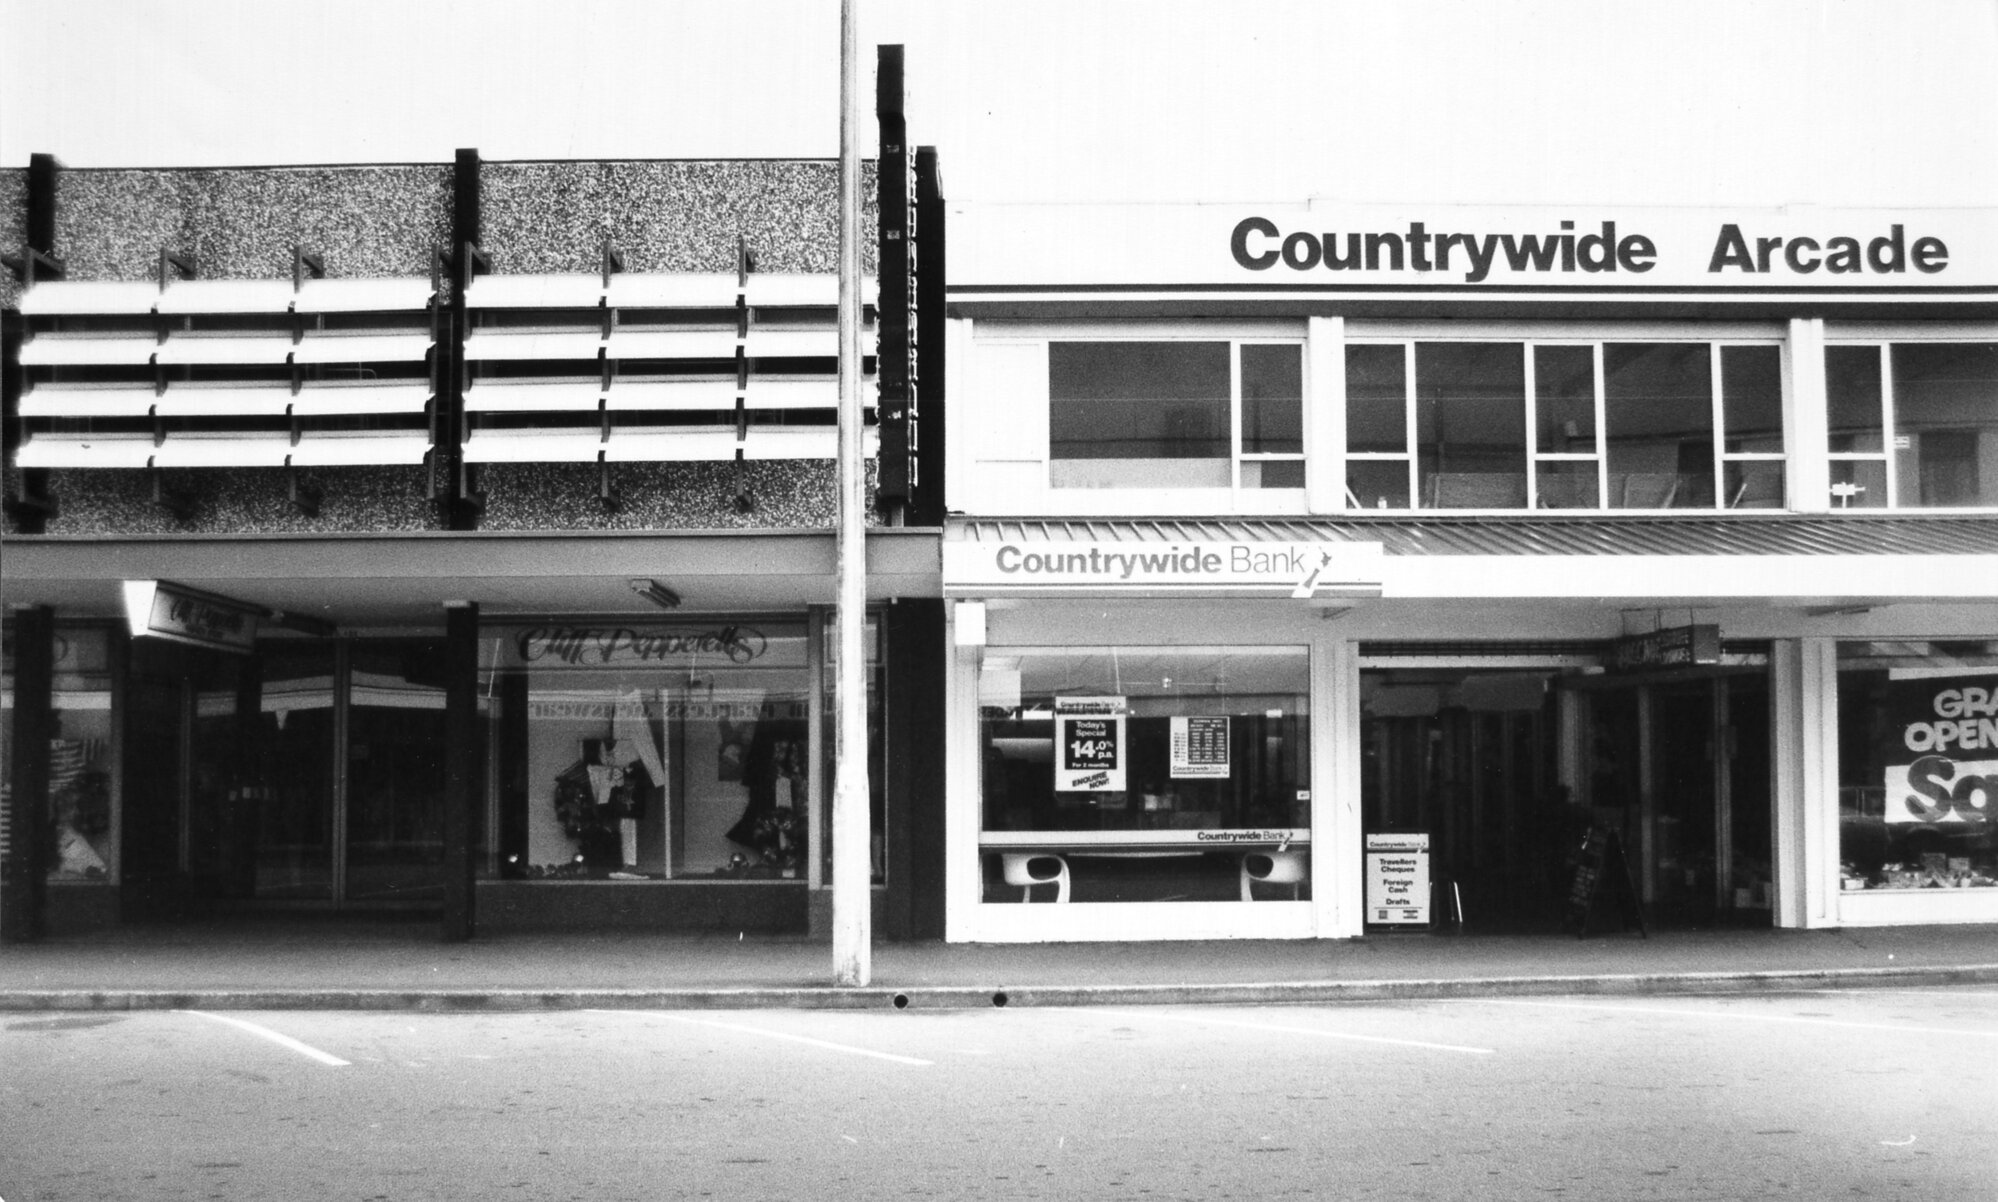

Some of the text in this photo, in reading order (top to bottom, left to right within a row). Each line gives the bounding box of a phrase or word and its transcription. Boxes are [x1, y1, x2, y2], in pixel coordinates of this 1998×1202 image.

[1231, 217, 1949, 283] Countrywide Arcade
[996, 545, 1305, 580] Countrywide Bank
[1076, 721, 1106, 729] Today's
[1076, 729, 1106, 737] Special
[1197, 831, 1286, 843] Countrywide Bank
[1379, 858, 1417, 866] Travellers
[1383, 879, 1413, 887] Foreign
